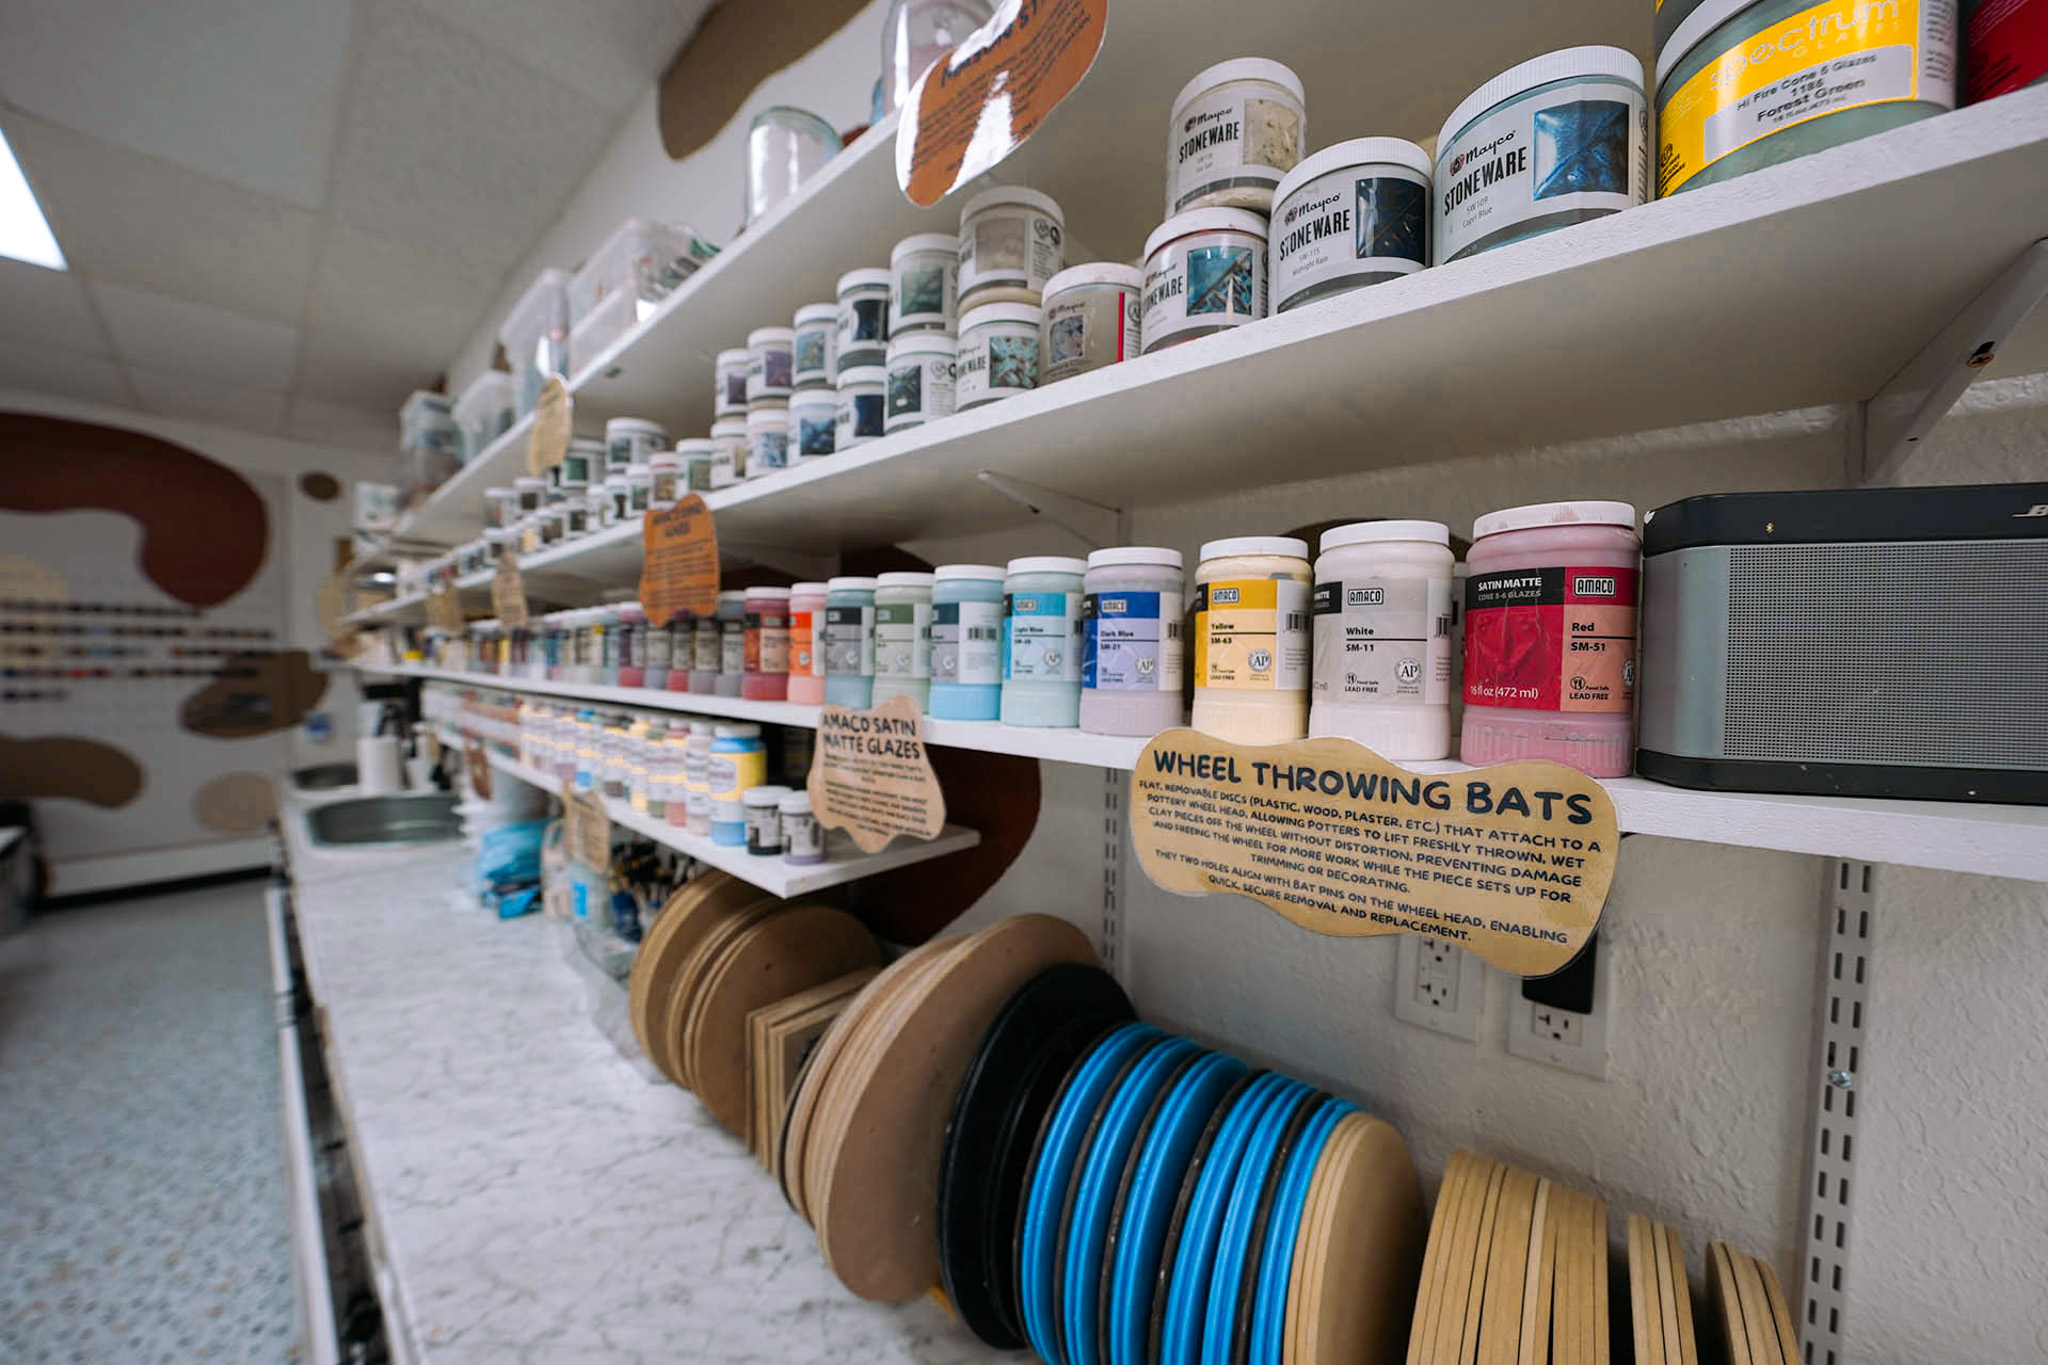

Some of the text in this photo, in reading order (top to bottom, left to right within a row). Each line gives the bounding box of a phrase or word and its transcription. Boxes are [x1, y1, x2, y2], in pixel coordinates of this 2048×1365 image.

[1710, 0, 1898, 91] spectrum
[1737, 97, 1750, 111] Hi
[1753, 87, 1777, 103] Fire
[1780, 70, 1817, 90] Cone
[1831, 54, 1878, 72] Glazes
[1757, 93, 1810, 122] Forest
[1813, 79, 1866, 98] Green
[1197, 106, 1233, 125] Mayco
[1179, 121, 1240, 164] STONEWARE
[1466, 131, 1515, 164] Mayco
[1444, 146, 1527, 216] STONEWARE
[1299, 193, 1340, 217] Mayco
[1280, 209, 1350, 261] STONEWARE
[1349, 589, 1382, 604] AMACO
[1478, 577, 1542, 592] SATIN MATTE
[1507, 589, 1541, 598] GLAZES
[1576, 578, 1614, 595] AMACO
[1346, 627, 1374, 635] White
[1572, 623, 1595, 632] Red
[1254, 655, 1269, 666] AP
[1346, 643, 1374, 652] SM-11
[1570, 642, 1605, 651] SM-51
[1401, 665, 1418, 678] AP
[1483, 688, 1493, 696] oz
[1495, 686, 1517, 698] (472
[1519, 687, 1539, 700] ml)
[823, 713, 916, 737] AMACO SATIN
[824, 733, 921, 759] MATTE GLAZES
[1153, 750, 1593, 825] WHEEL THROWING BATS
[1147, 793, 1187, 807] POTTERY
[1189, 801, 1217, 813] WHEEL
[1251, 810, 1305, 828] ALLOWING
[1308, 820, 1360, 837] POTTERS
[1363, 829, 1381, 840] TO
[1384, 832, 1410, 844] LIFT
[1413, 836, 1472, 854] FRESHLY
[1551, 854, 1585, 869] WET
[1164, 783, 1218, 799] REMOVABLE
[1405, 818, 1440, 835] ETC.)
[1444, 824, 1484, 838] THAT
[1488, 830, 1556, 848] ATTACH
[1560, 838, 1583, 850] TO
[1588, 841, 1601, 852] A
[1148, 806, 1173, 818] CLAY
[1174, 810, 1204, 824] PIECES
[1206, 817, 1222, 826] OFF
[1225, 820, 1243, 832] THE
[1245, 825, 1278, 838] WHEEL
[1281, 830, 1332, 847] WITHOUT
[1417, 853, 1507, 876] PREVENTING
[1510, 867, 1582, 887] DAMAGE
[1153, 820, 1571, 903] AND FREEING THE WHEEL FOR MORE WORK WHILE THE PIECE SETS UP FOR
[1250, 854, 1411, 893] TRIMMING OR DECORATING.
[1155, 849, 1178, 861] THEY
[1179, 855, 1199, 866] TWO
[1201, 860, 1229, 873] HOLES
[1232, 867, 1262, 880] ALIGN
[1263, 874, 1291, 888] WITH
[1293, 880, 1315, 892] BAT
[1319, 886, 1345, 900] PINS
[1348, 892, 1367, 904] ON
[1370, 896, 1394, 910] THE
[1397, 902, 1440, 919] WHEEL
[1490, 920, 1568, 944] ENABLING
[1242, 882, 1281, 900] SECURE
[1283, 892, 1337, 913] REMOVAL
[1340, 906, 1367, 919] AND
[1370, 912, 1472, 942] REPLACEMENT.
